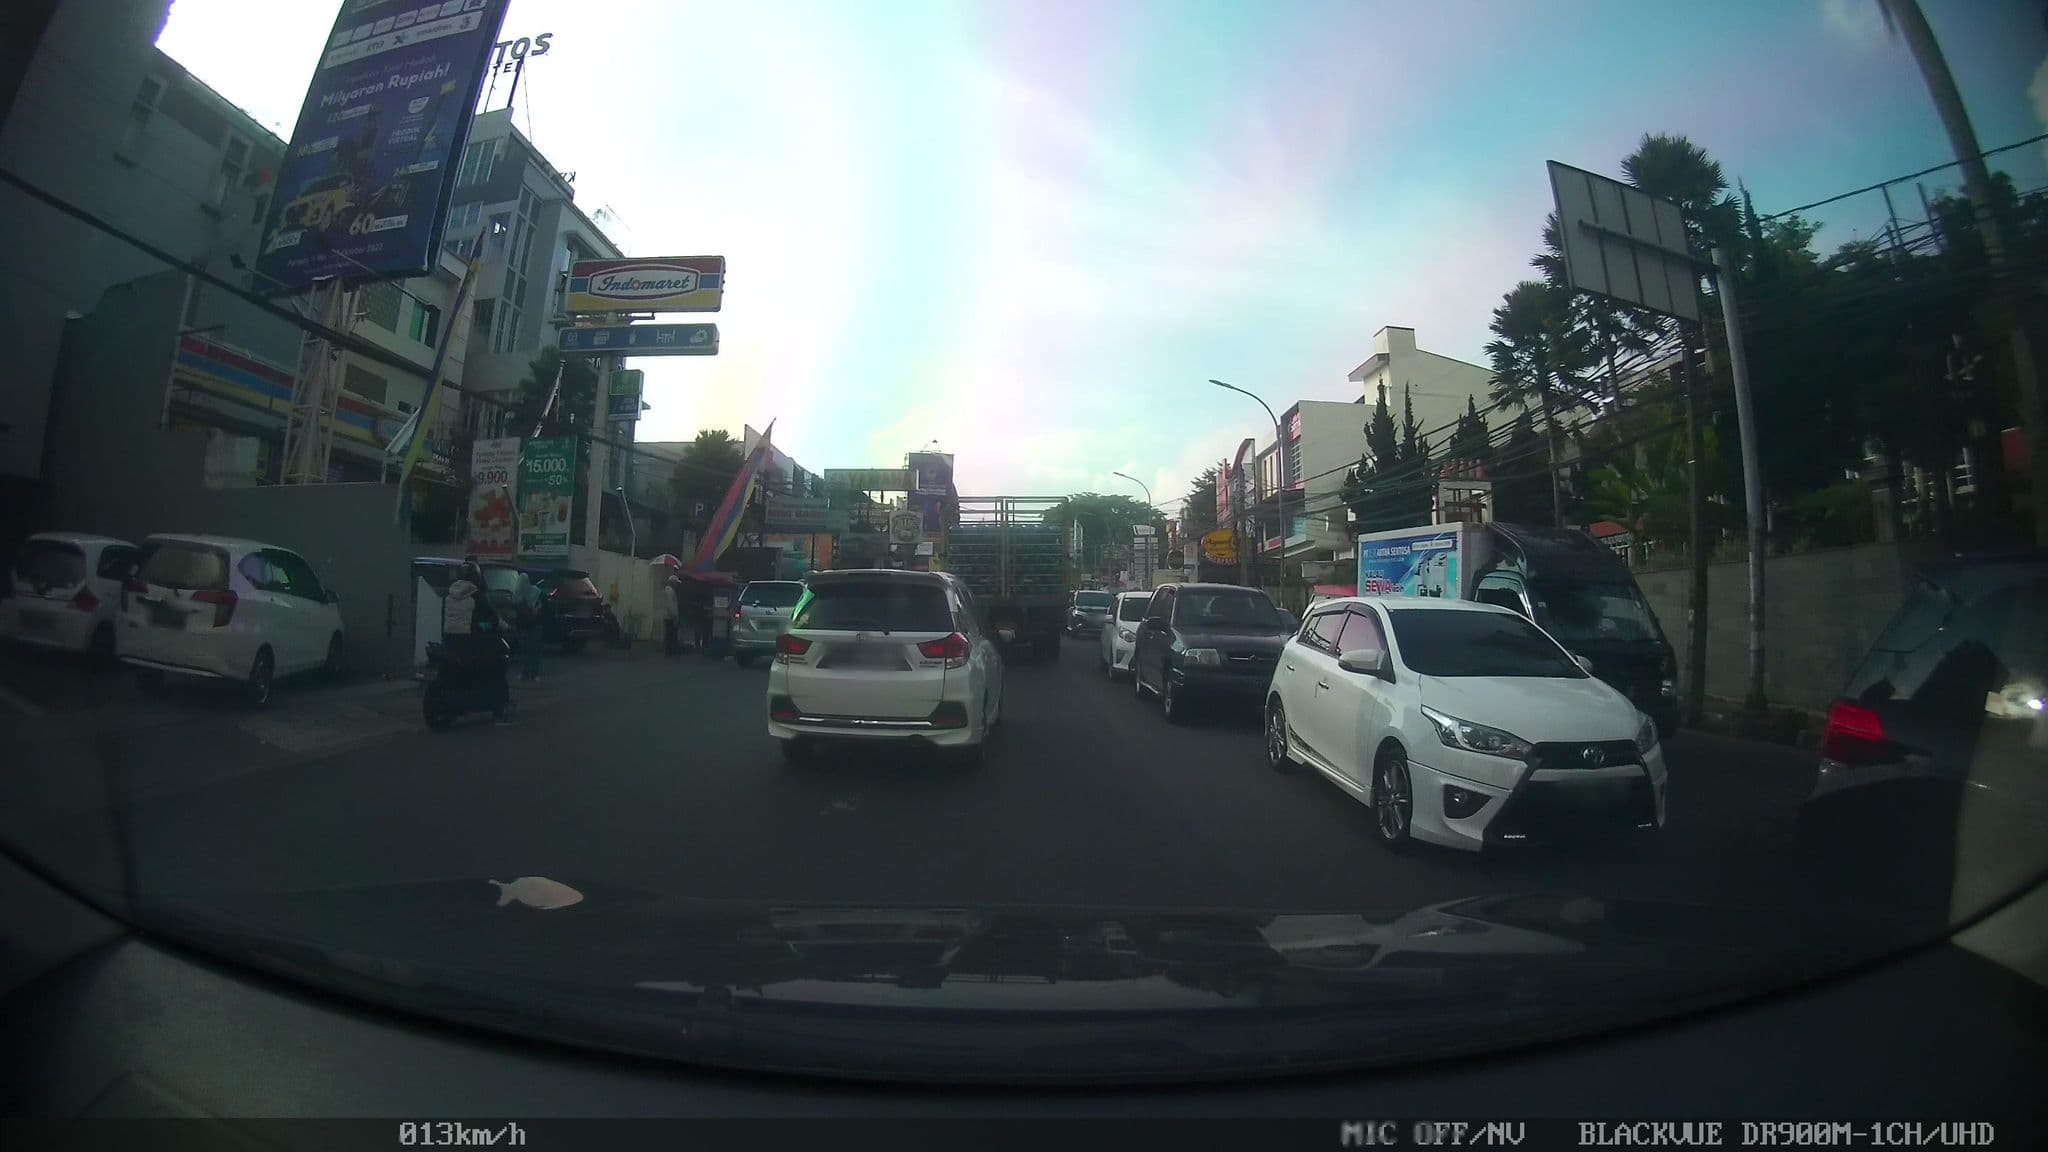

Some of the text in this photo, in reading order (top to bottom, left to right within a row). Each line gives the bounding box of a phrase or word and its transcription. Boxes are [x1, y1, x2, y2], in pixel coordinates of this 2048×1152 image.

[320, 82, 384, 107] Milyaran
[387, 62, 451, 89] Rupiah!
[598, 275, 689, 291] Indomaret
[1365, 579, 1393, 593] SEWA
